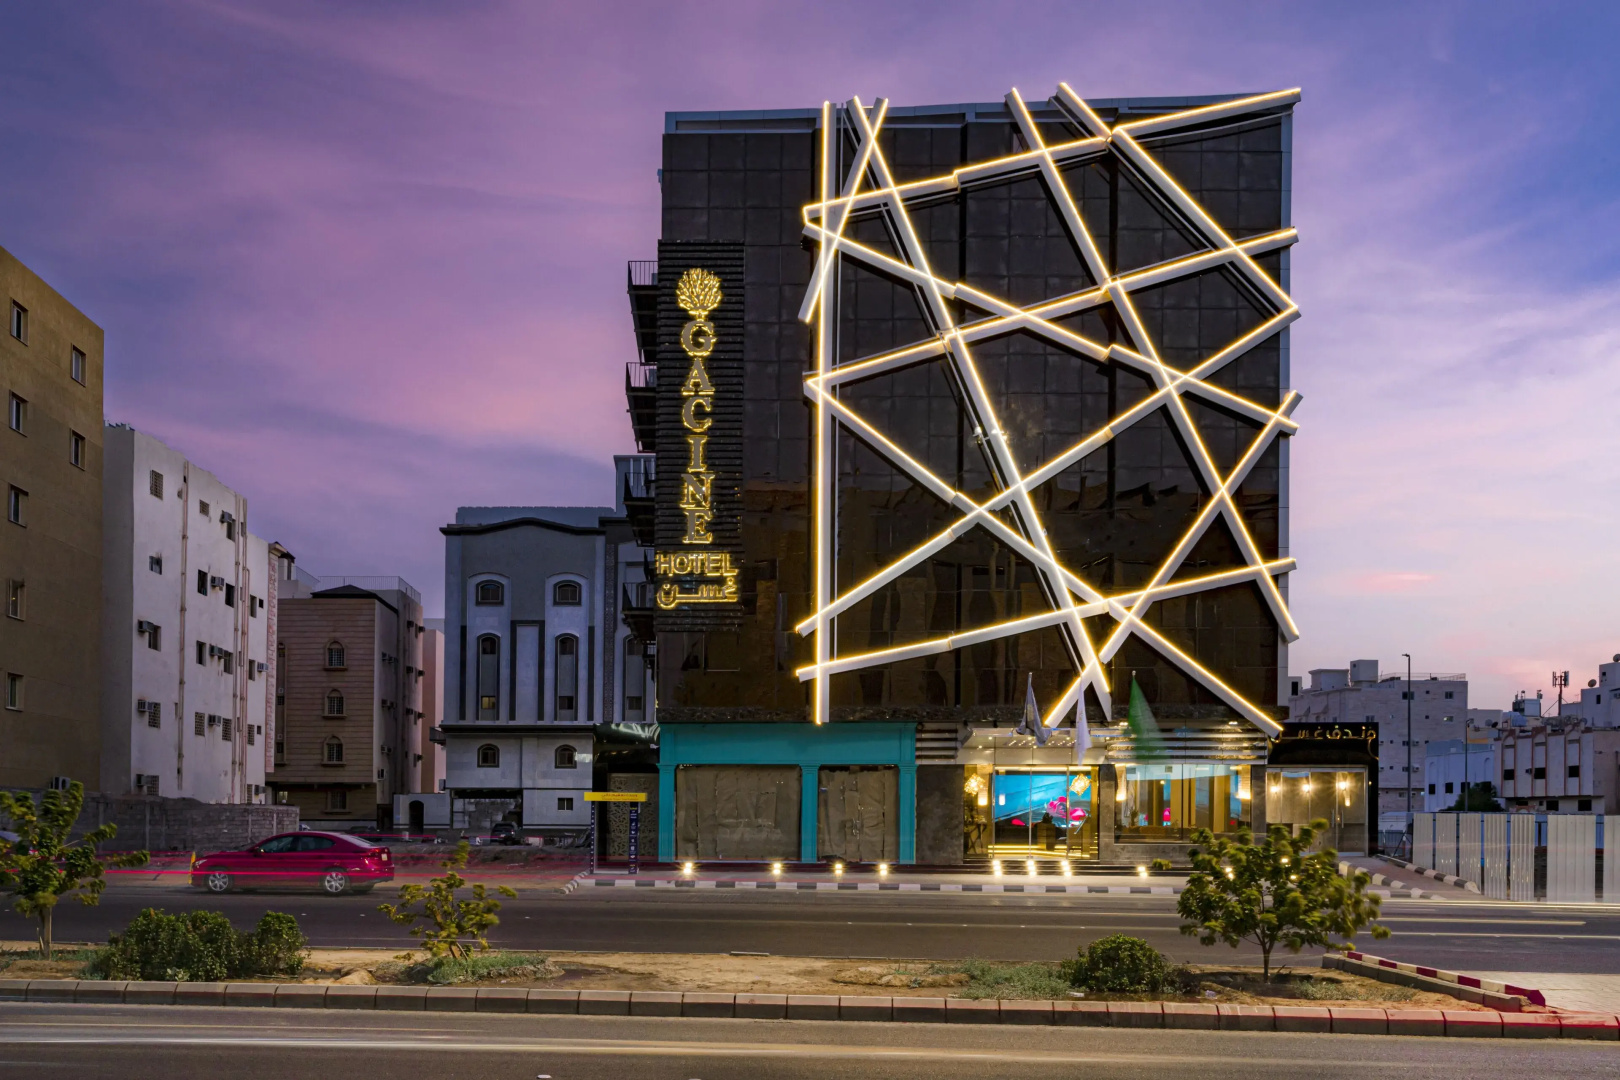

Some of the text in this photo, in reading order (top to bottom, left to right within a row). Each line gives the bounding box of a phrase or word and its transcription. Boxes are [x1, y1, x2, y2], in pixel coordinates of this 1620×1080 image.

[680, 319, 717, 544] GACINE
[656, 551, 738, 576] HOTEL
[657, 577, 738, 610] غسن
